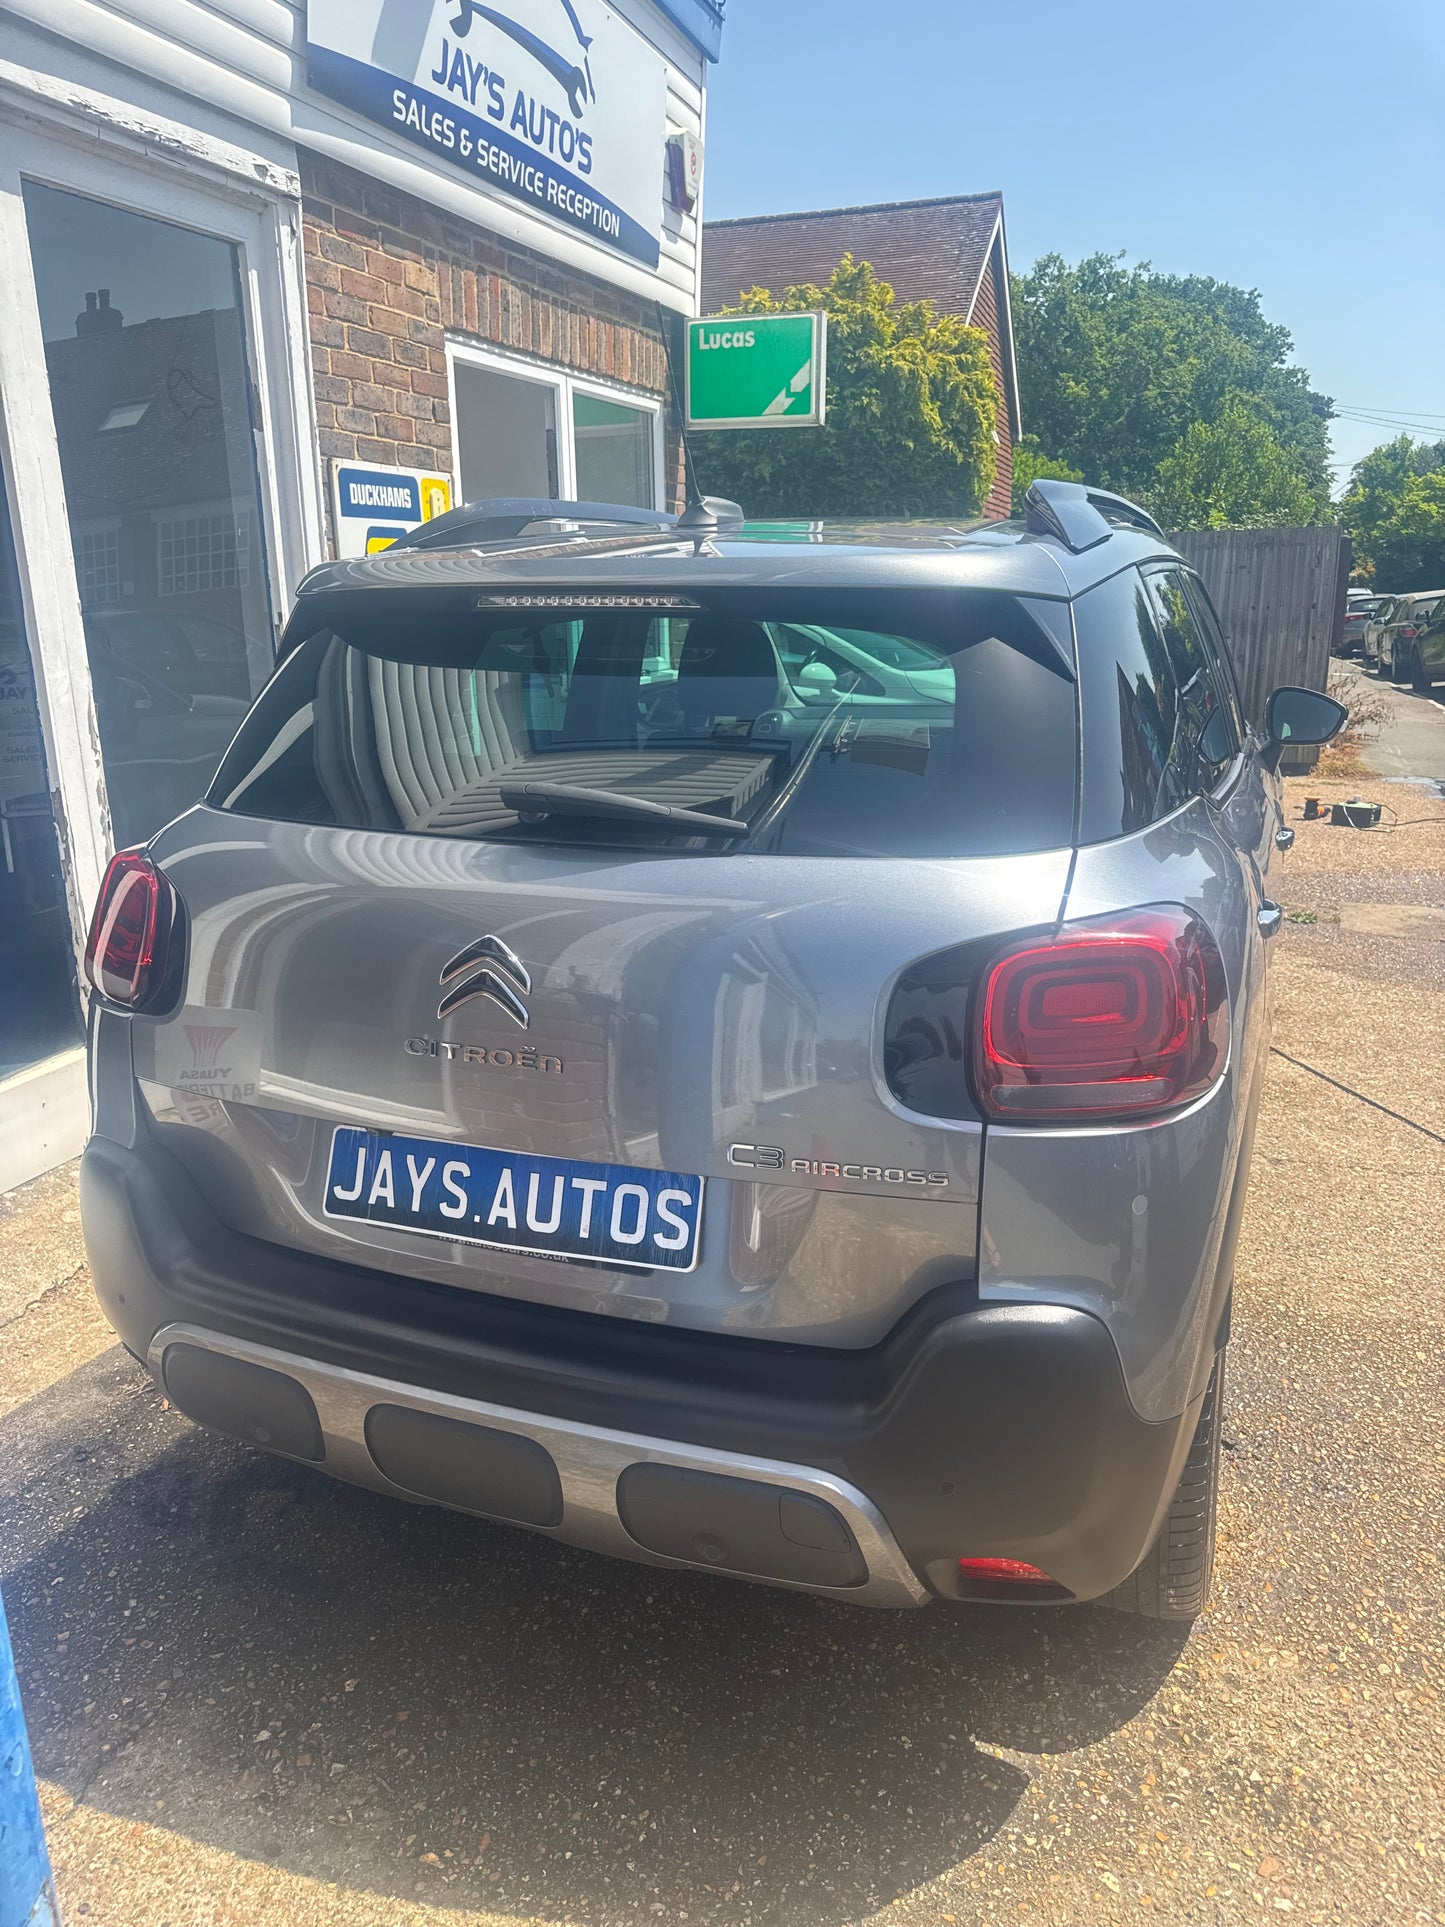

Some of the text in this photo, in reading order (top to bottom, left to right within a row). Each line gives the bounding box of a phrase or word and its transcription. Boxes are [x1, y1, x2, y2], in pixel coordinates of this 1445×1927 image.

[432, 38, 593, 175] JAY'S AUTO'S
[392, 88, 620, 238] SALES & SERVICE RECEPTION
[698, 328, 756, 350] Lucas
[349, 483, 412, 509] DUCKHAMS
[403, 1037, 563, 1074] CITROËN
[727, 1142, 950, 1187] C3 AIRCROSS
[332, 1146, 693, 1251] JAYS.AUTOS
